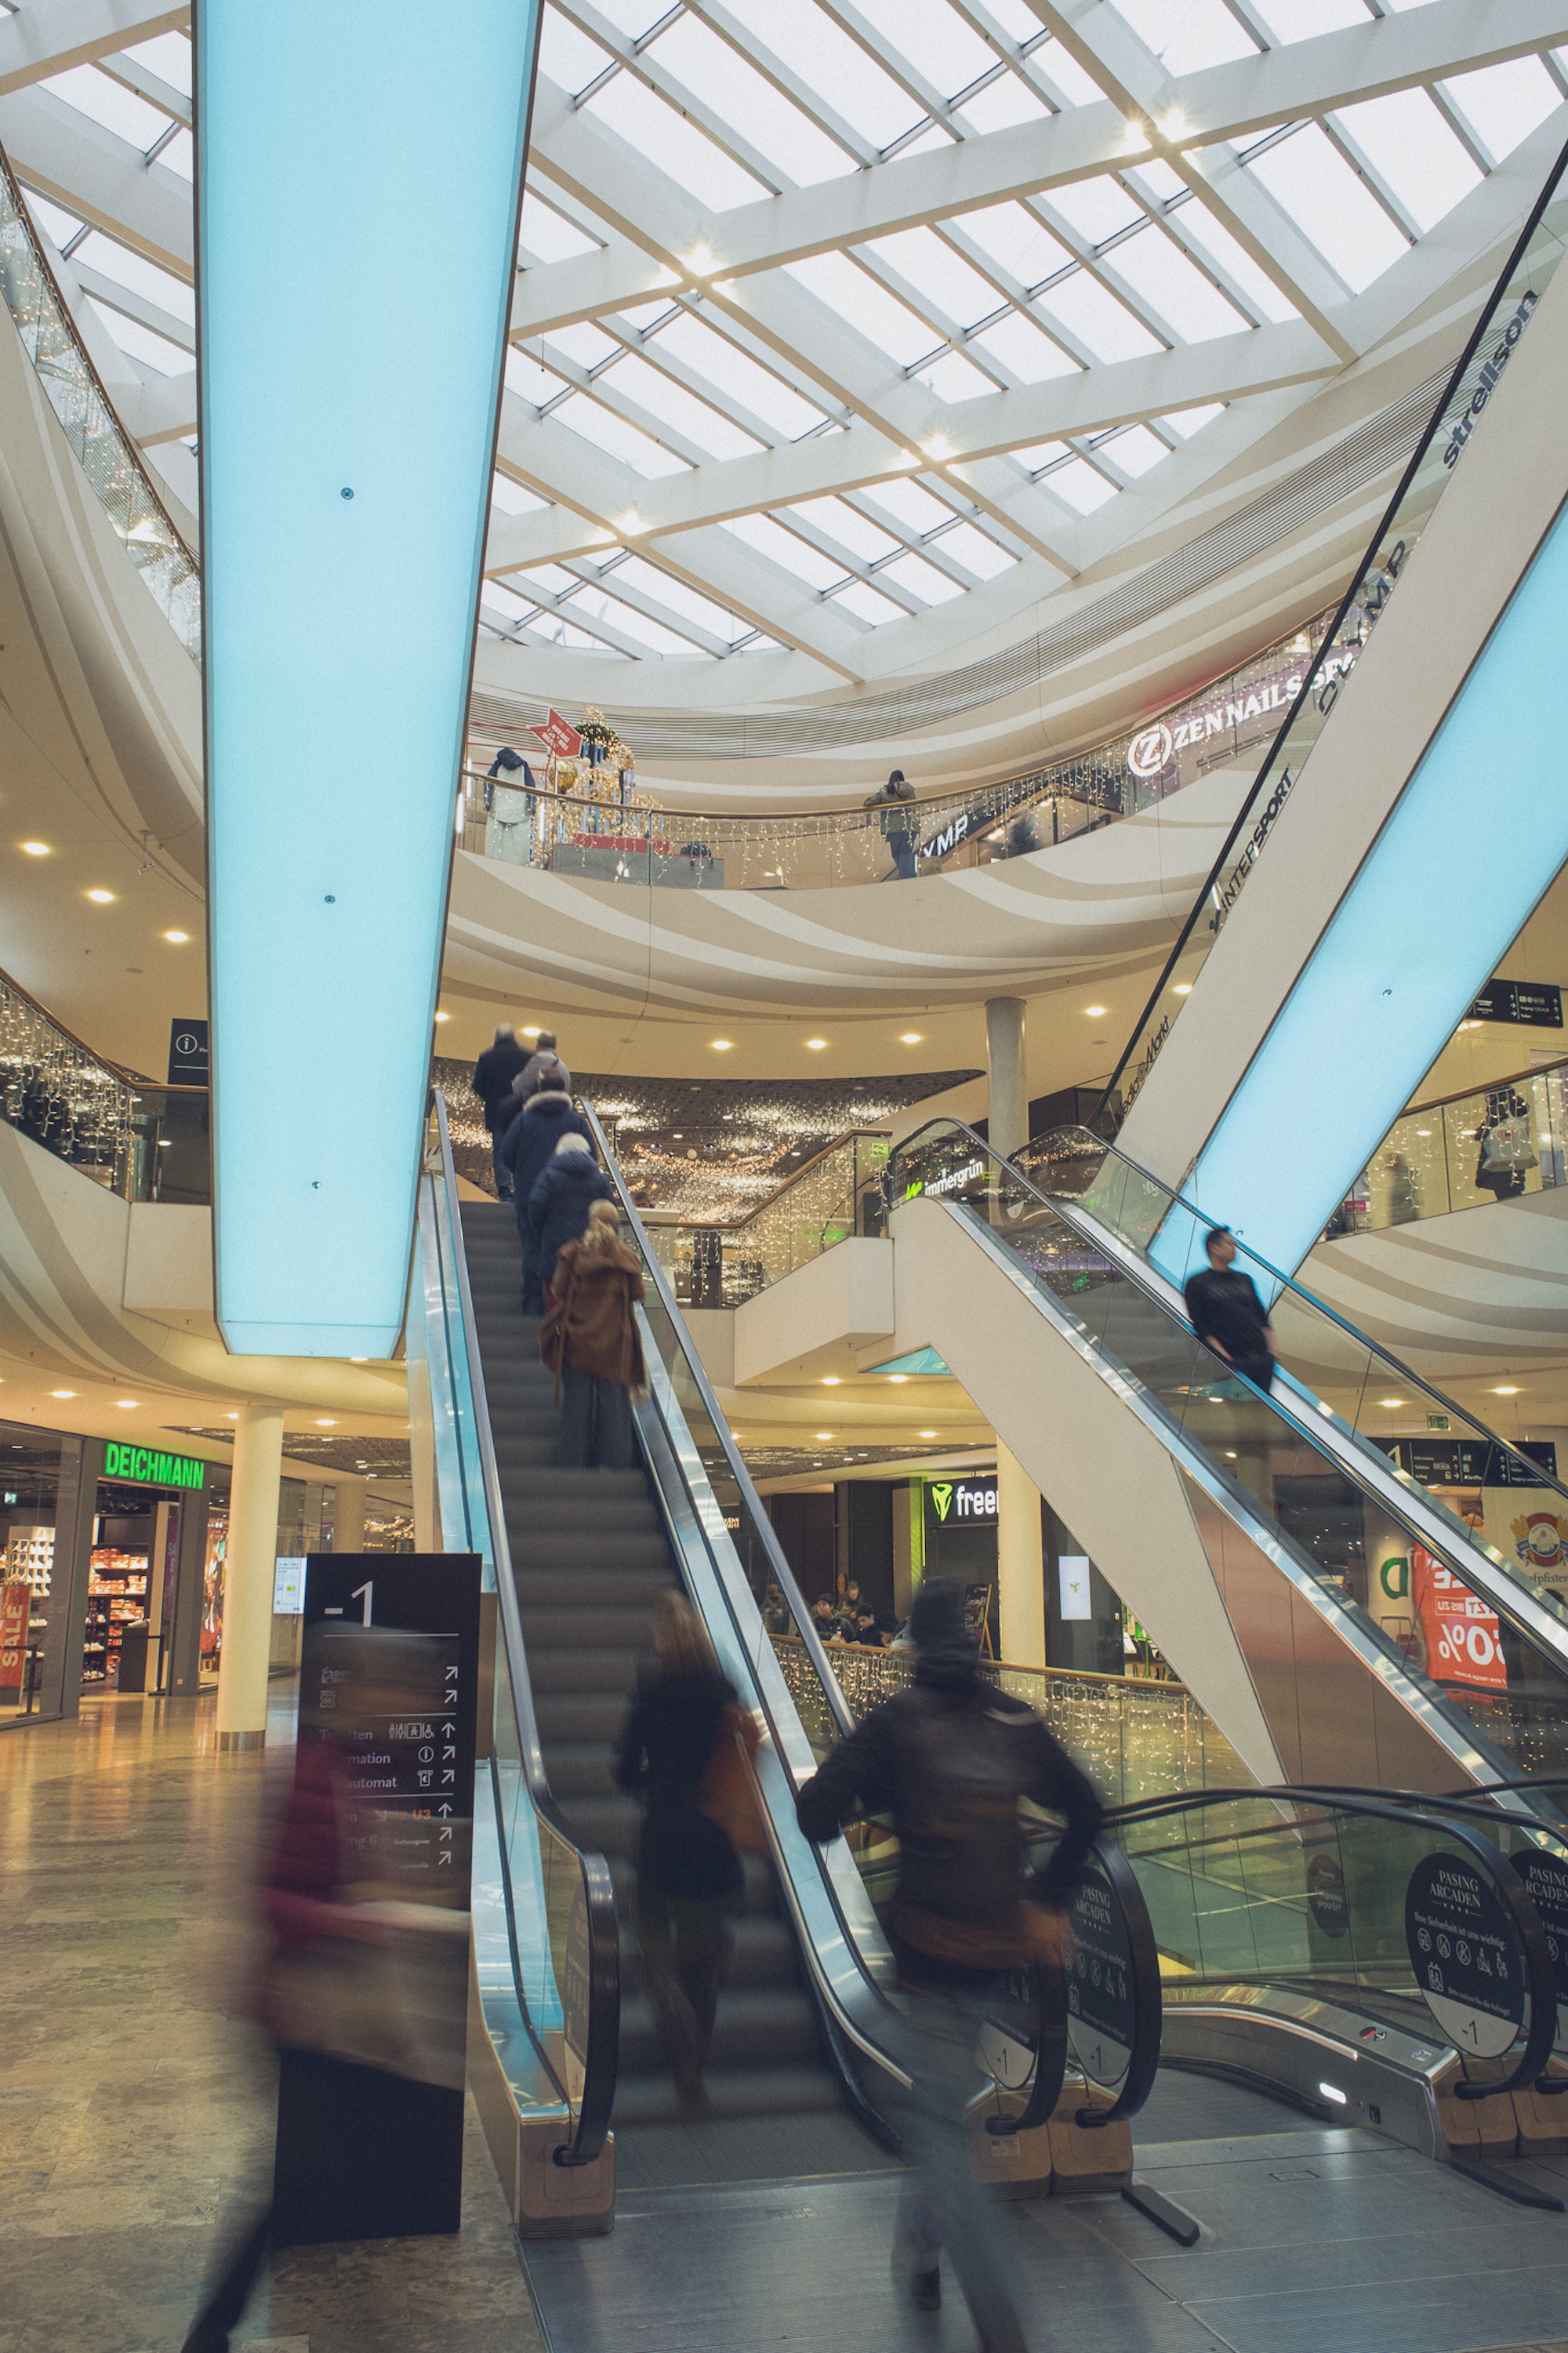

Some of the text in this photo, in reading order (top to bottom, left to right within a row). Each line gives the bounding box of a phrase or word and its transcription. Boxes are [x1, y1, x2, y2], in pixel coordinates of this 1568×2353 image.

[1443, 289, 1542, 469] strellson
[1174, 708, 1223, 750] ZEN
[1225, 675, 1302, 728] NAILS
[915, 815, 968, 873] YMP
[1221, 766, 1293, 913] INTERSPORT
[924, 1158, 983, 1196] immergrün
[104, 1442, 205, 1491] DEICHMANN
[956, 1485, 999, 1516] free
[1529, 1572, 1568, 1585] fpfister
[324, 1581, 373, 1628] -1
[2, 1603, 24, 1668] SALE
[347, 1752, 390, 1764] mation
[347, 1777, 397, 1788] automat
[412, 1809, 431, 1821] U3
[1439, 1869, 1479, 1893] PASING
[1525, 1879, 1568, 1903] RCADE
[1082, 1884, 1111, 1908] PASING
[1429, 1883, 1482, 1908] ARCADEN
[1075, 1899, 1112, 1926] ARCADEN
[1414, 1911, 1427, 1923] Ihre
[1427, 1915, 1458, 1934] Sicherheit
[1458, 1925, 1467, 1937] ist
[1467, 1931, 1479, 1941] uns
[1462, 2019, 1478, 2046] -1
[996, 2047, 1008, 2075] -1
